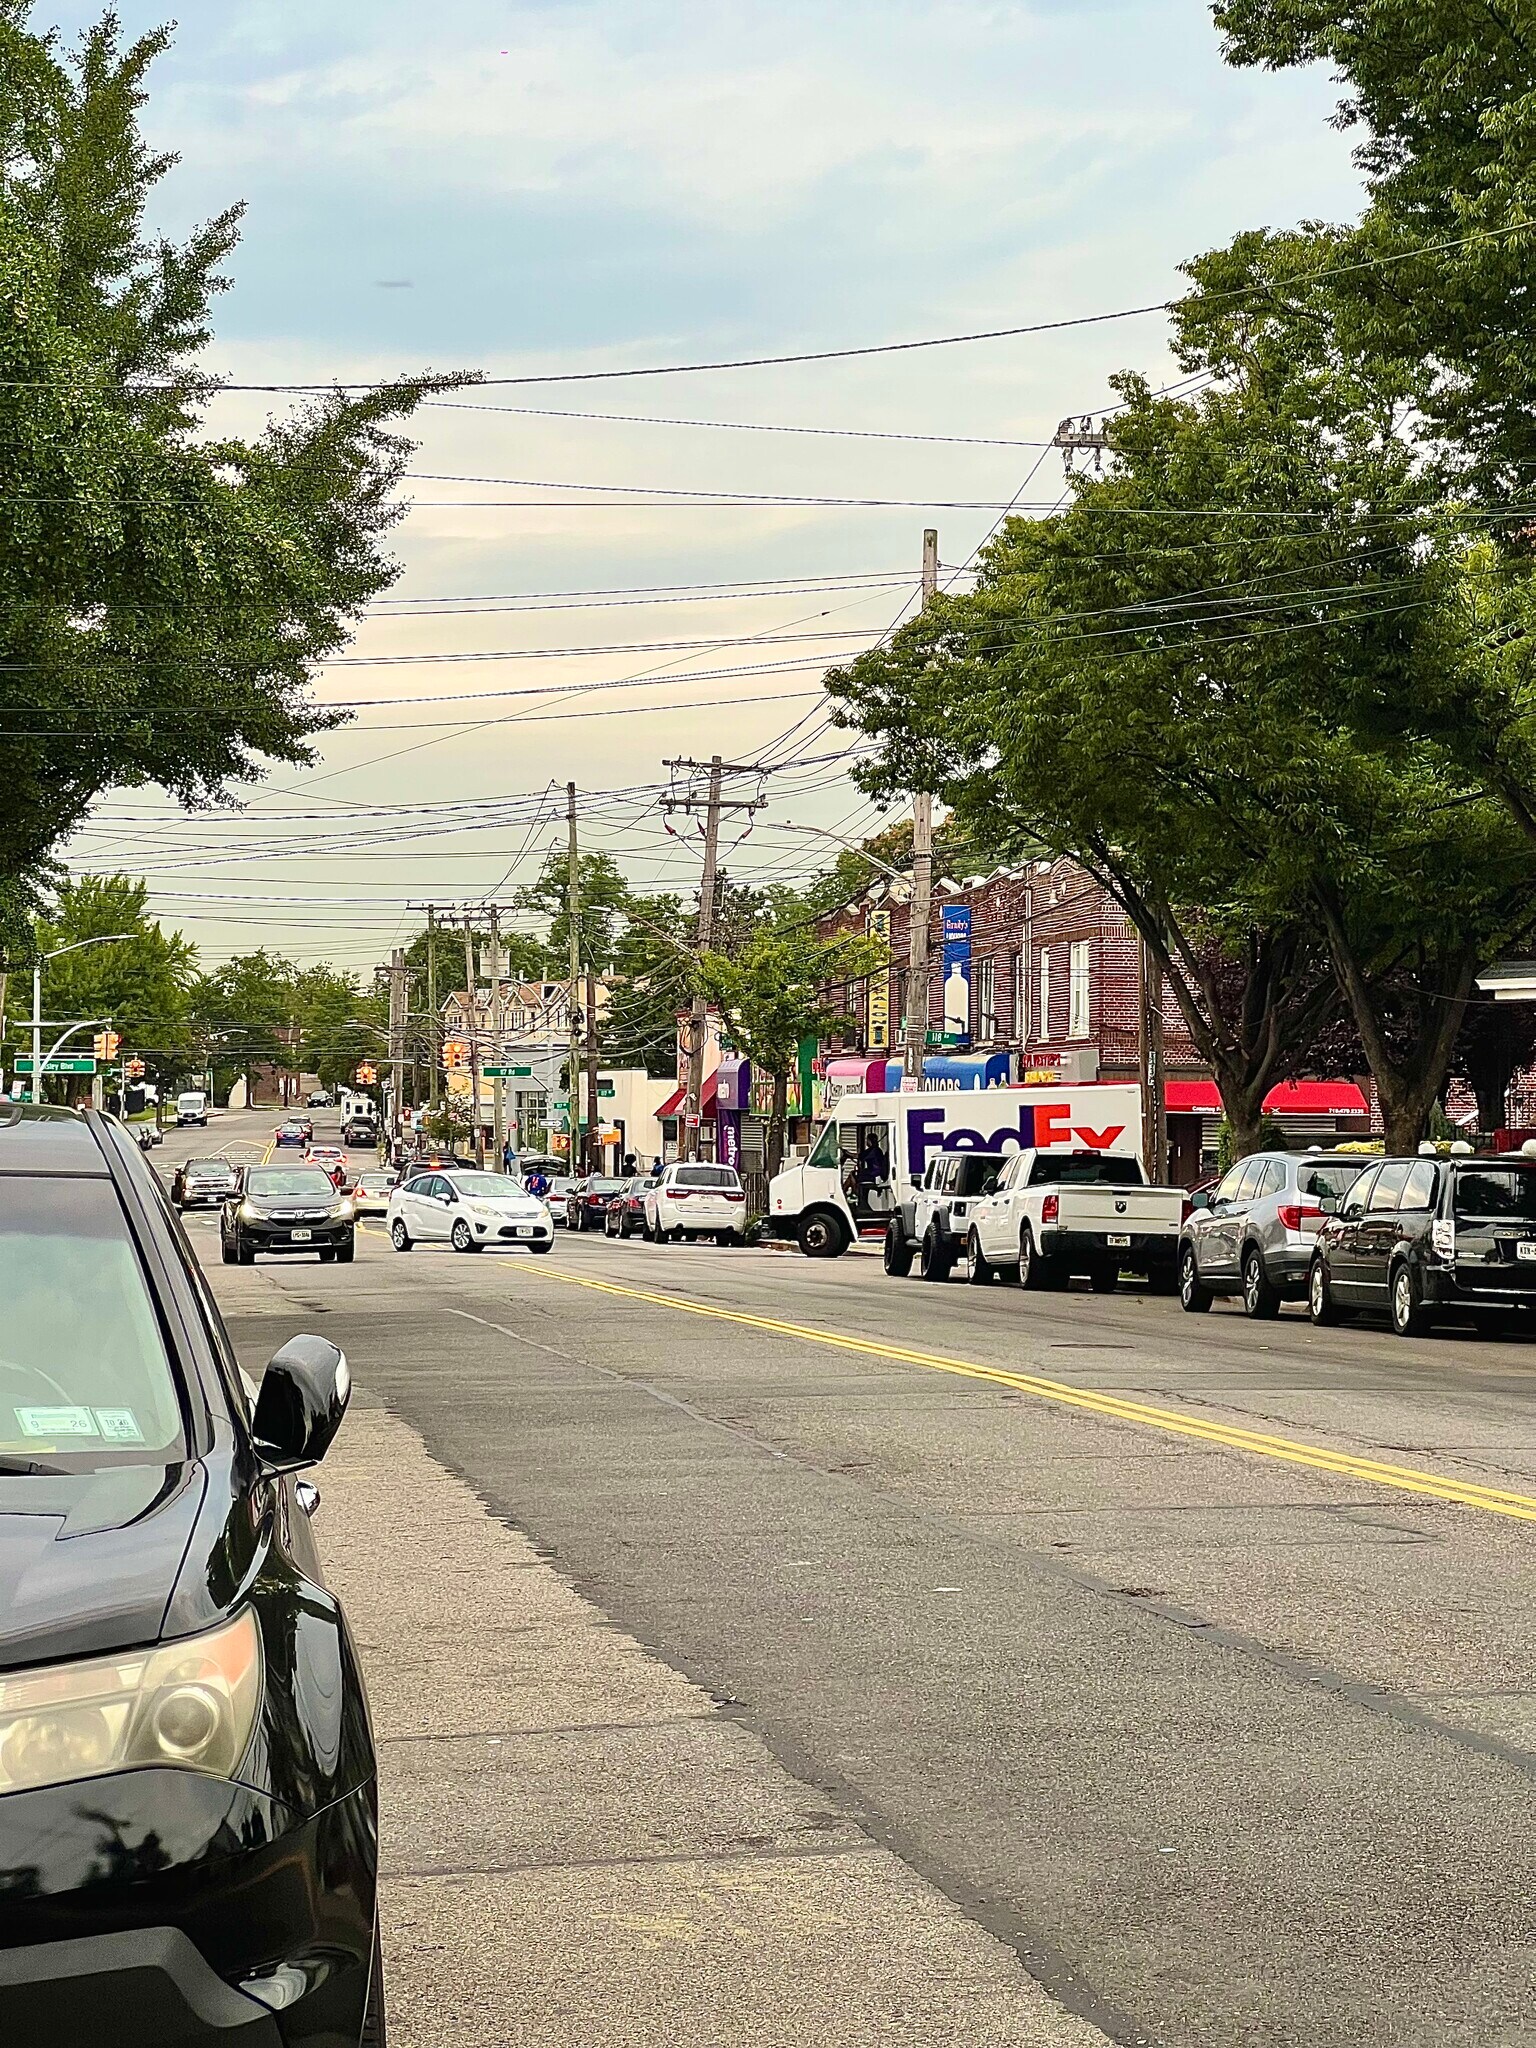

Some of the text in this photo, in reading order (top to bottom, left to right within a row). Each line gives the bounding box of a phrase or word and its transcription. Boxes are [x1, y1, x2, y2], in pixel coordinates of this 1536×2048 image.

[931, 1032, 942, 1042] 118
[60, 1062, 74, 1070] Blvd
[906, 1103, 1126, 1174] FedEx
[726, 1126, 738, 1166] metro
[70, 1420, 88, 1428] 26
